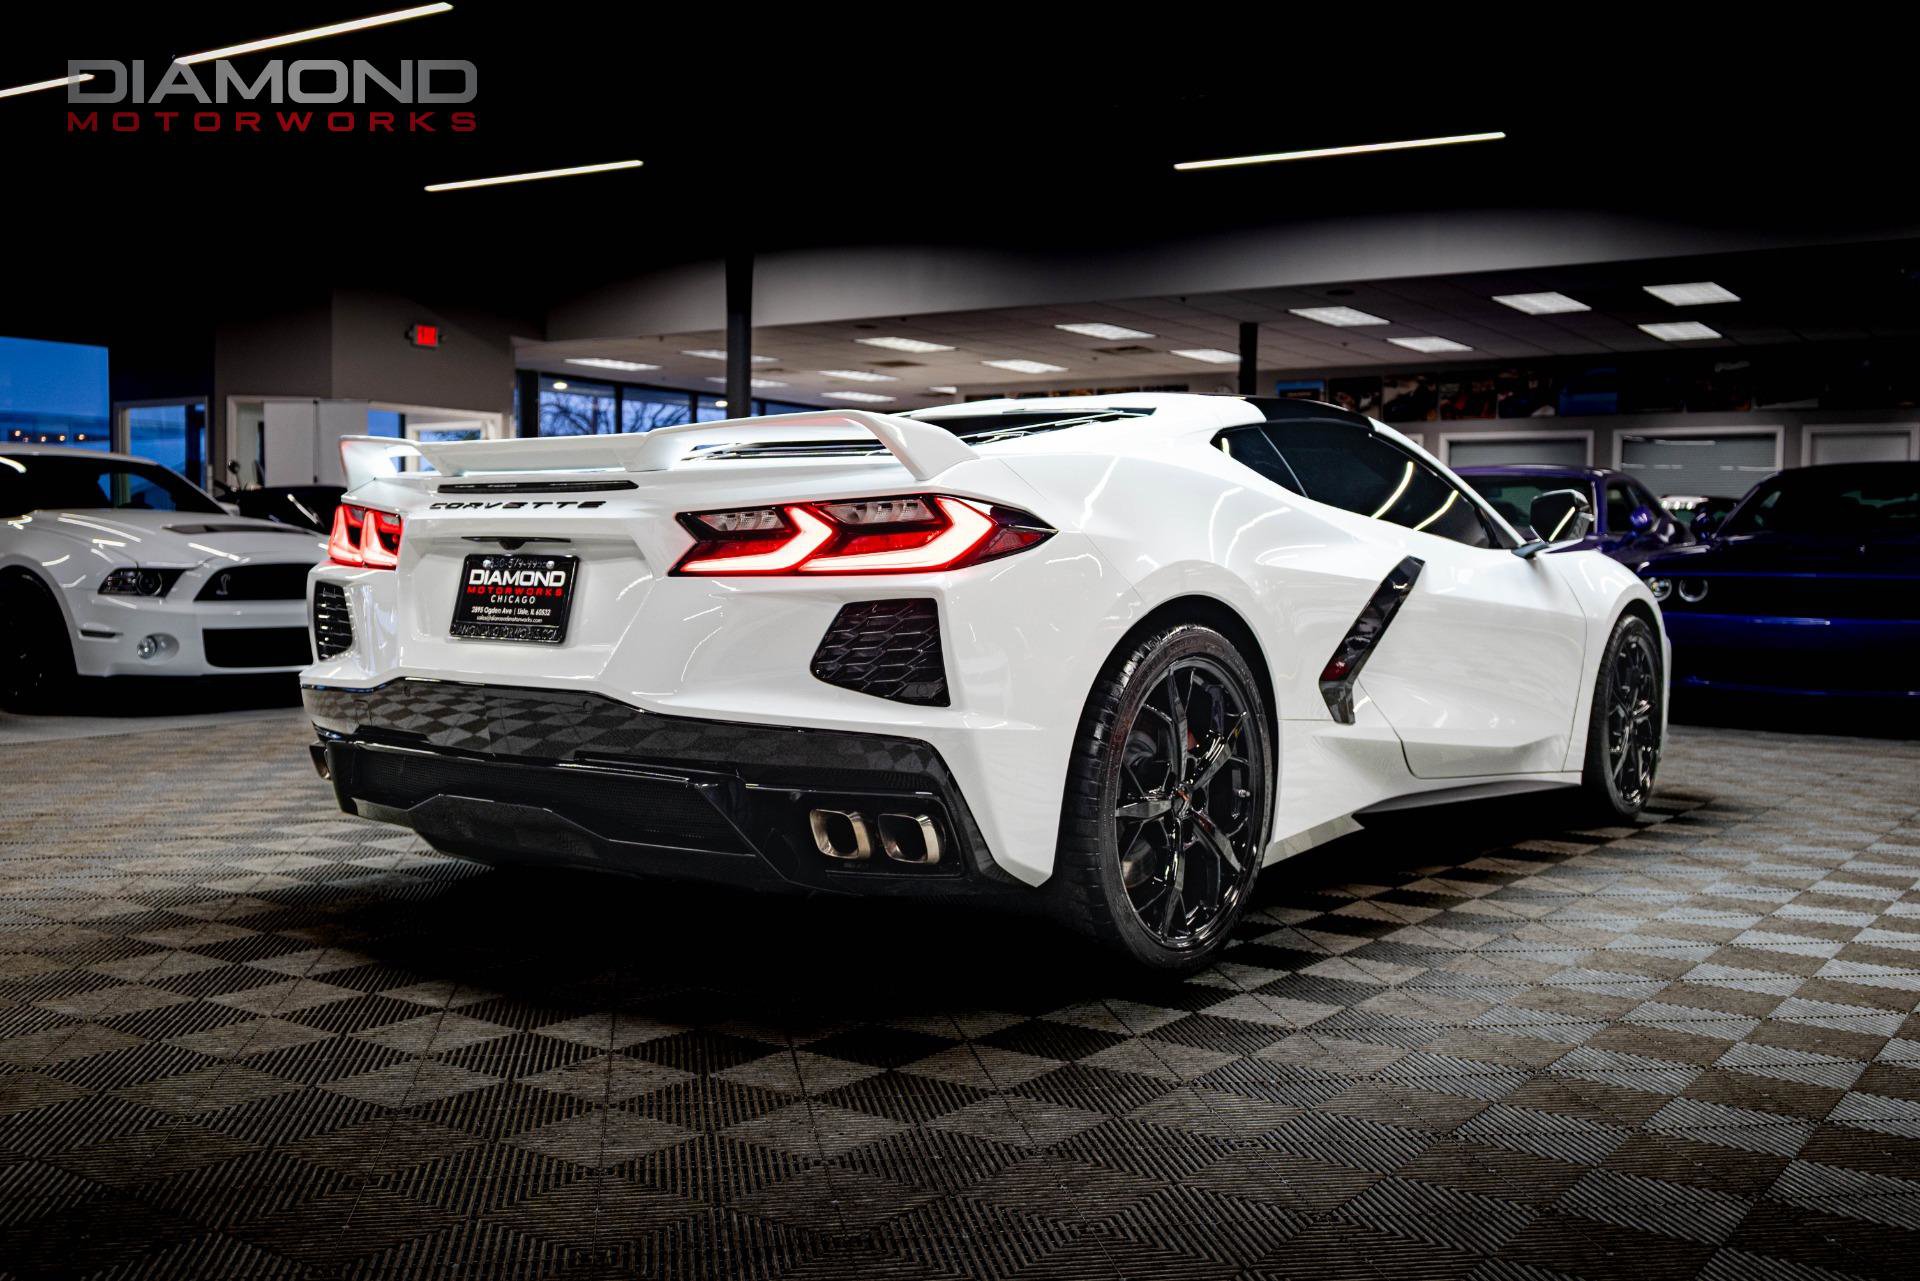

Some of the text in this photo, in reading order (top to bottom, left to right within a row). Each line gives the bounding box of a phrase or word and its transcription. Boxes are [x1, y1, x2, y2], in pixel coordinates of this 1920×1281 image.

[429, 501, 607, 510] CORVETTE
[468, 569, 567, 587] DIAMOND
[466, 586, 565, 597] MOTORWORKS
[490, 594, 537, 605] CHICAGO
[484, 607, 501, 615] Ogden
[502, 607, 513, 615] Ave
[535, 609, 552, 617] 60532
